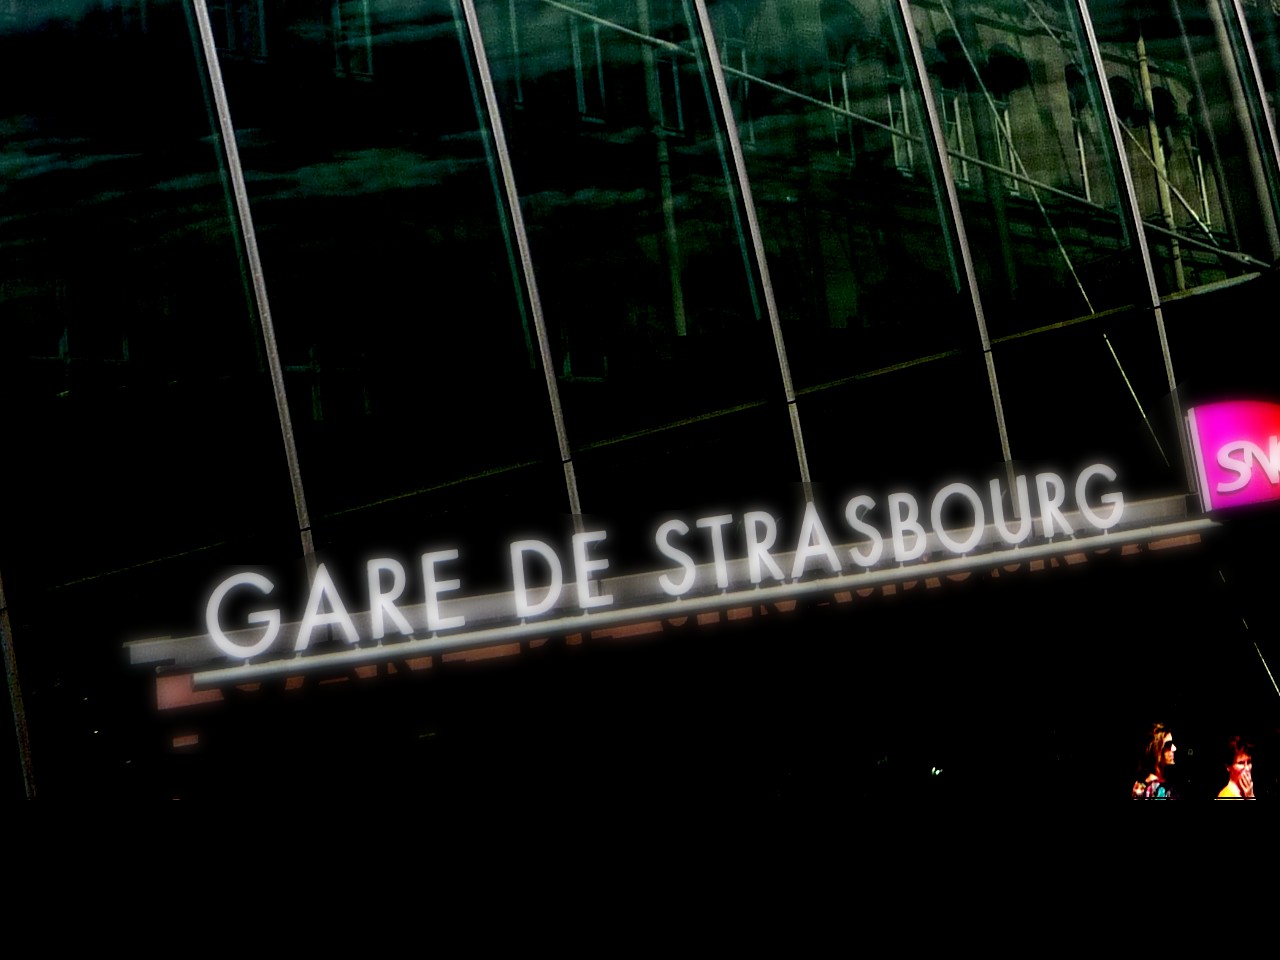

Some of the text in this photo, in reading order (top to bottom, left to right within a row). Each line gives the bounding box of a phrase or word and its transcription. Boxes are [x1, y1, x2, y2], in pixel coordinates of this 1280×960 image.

[205, 463, 1126, 659] GARE DE STRASBOURG
